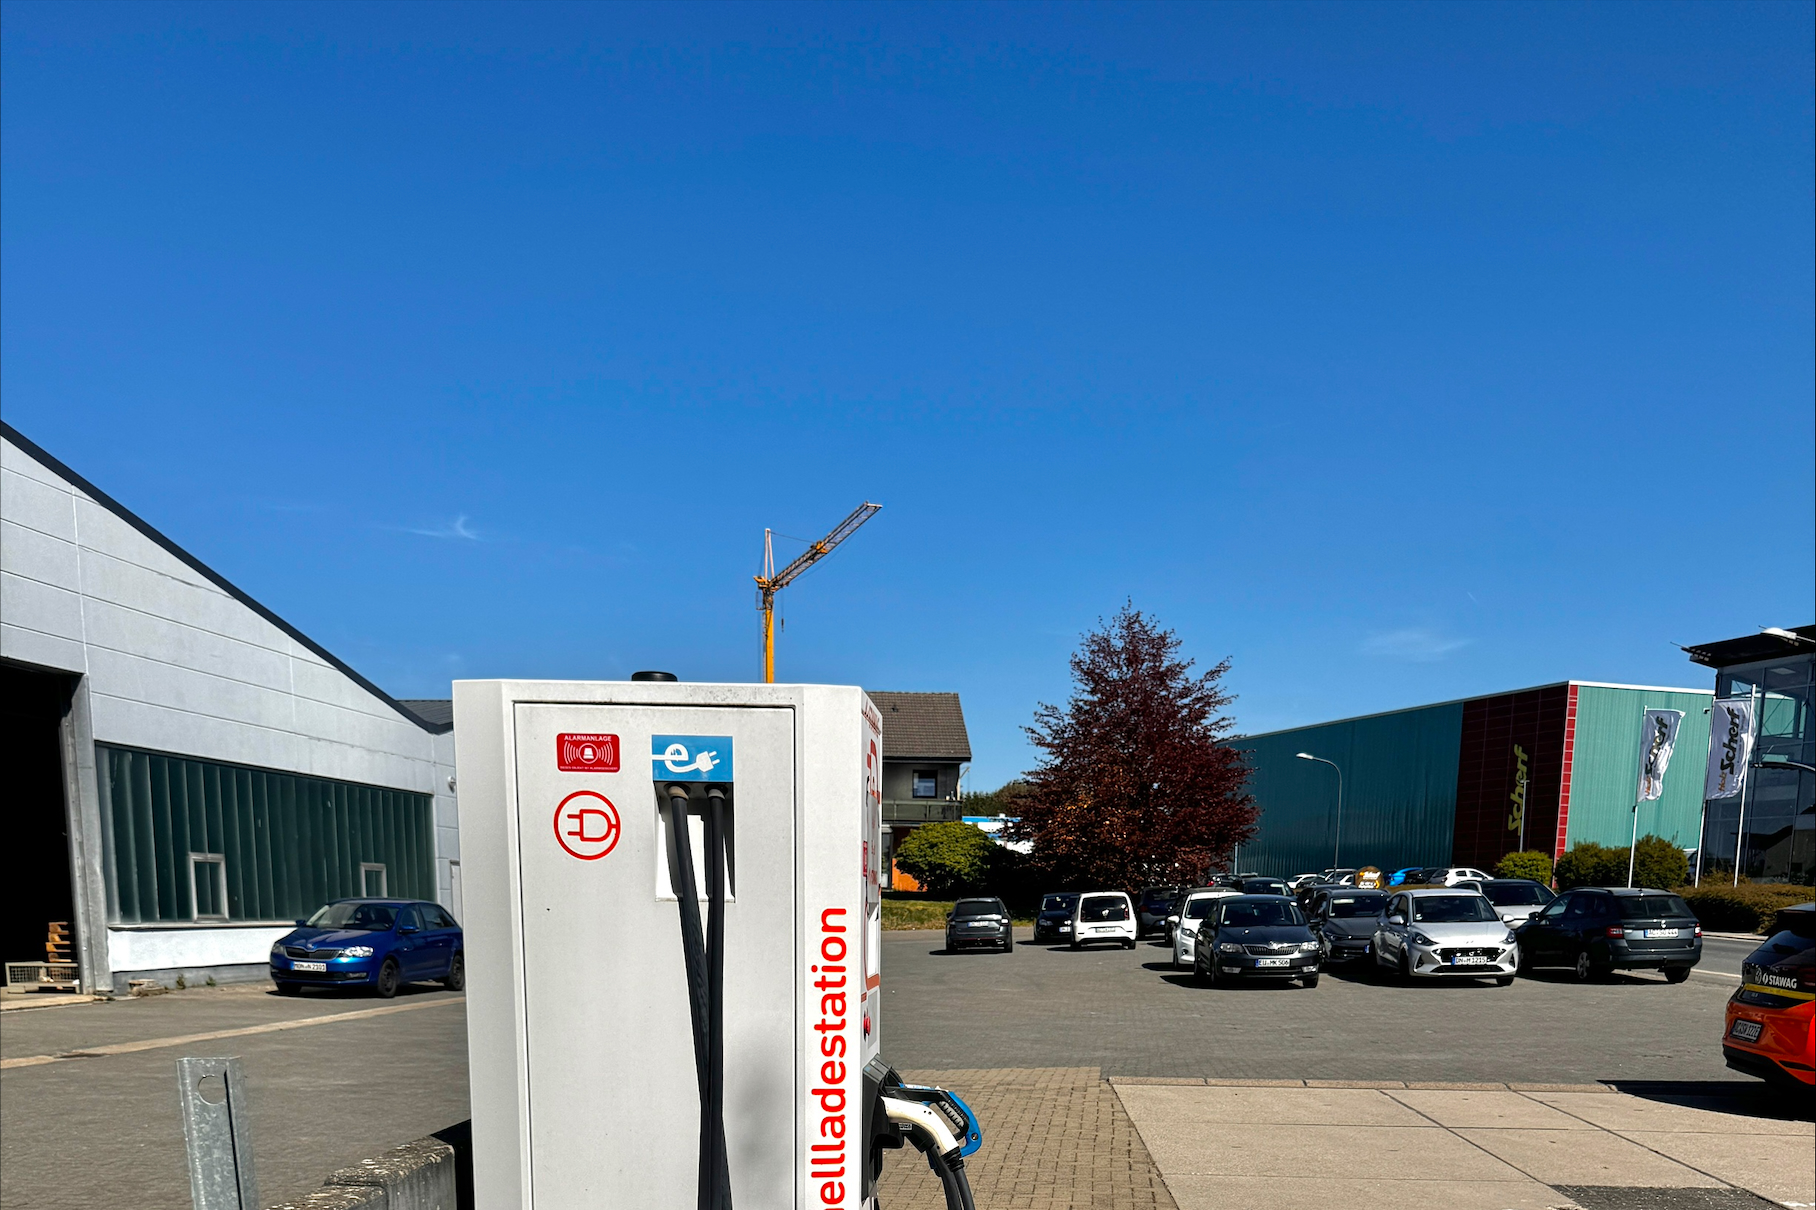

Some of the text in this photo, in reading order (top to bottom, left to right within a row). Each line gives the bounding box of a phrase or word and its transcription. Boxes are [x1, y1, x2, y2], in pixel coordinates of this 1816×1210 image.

[1720, 706, 1740, 775] Scherf
[1508, 744, 1529, 836] Scherf
[1768, 974, 1798, 990] STAWAG
